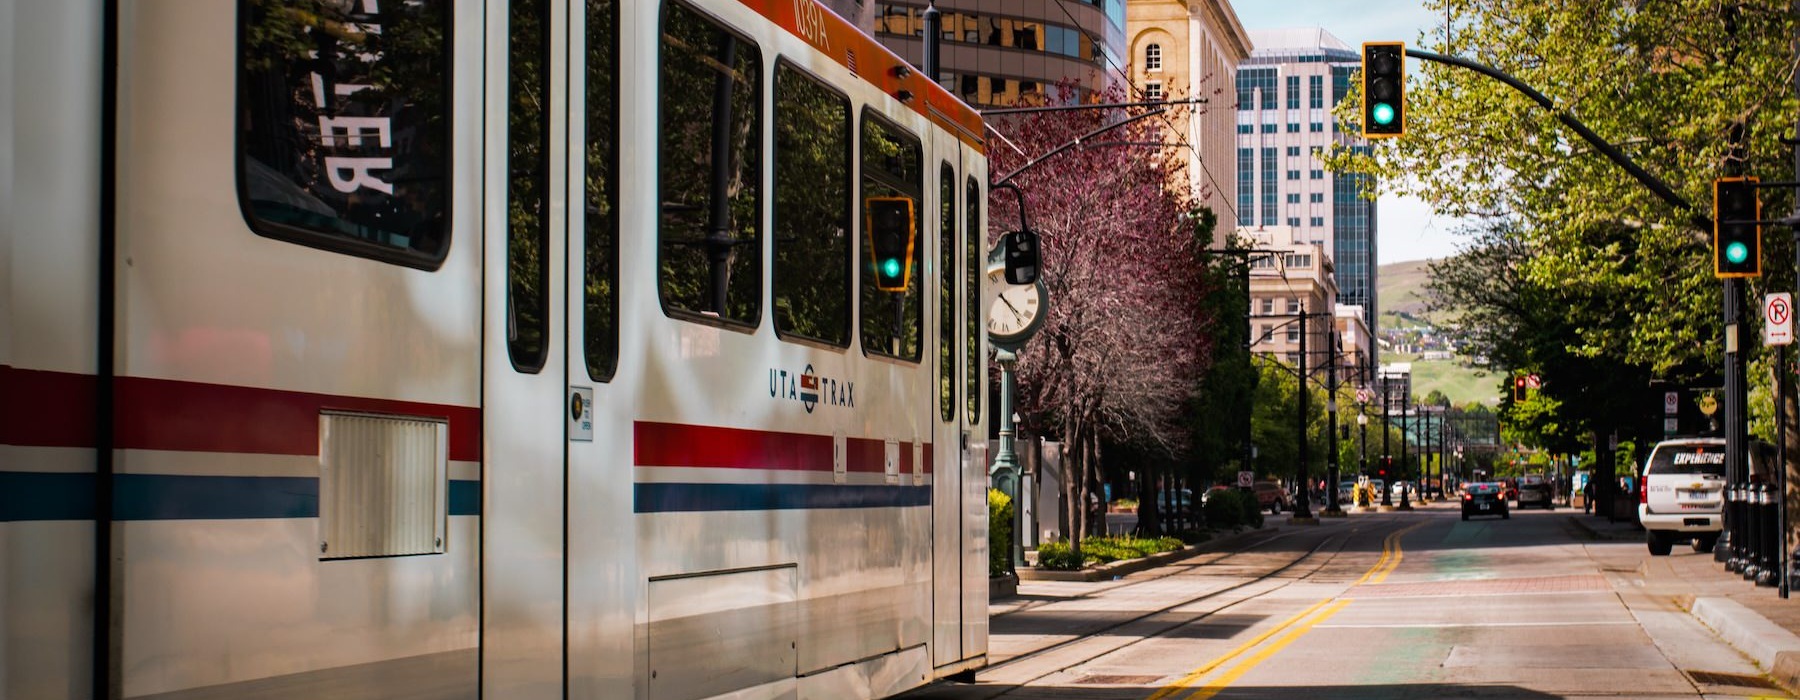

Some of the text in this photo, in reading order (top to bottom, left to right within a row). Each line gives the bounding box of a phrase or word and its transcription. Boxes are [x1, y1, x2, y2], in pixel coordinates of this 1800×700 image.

[793, 0, 831, 51] 1039A
[769, 368, 854, 408] UTA TRAX
[1673, 453, 1725, 465] EXPERIENCE
